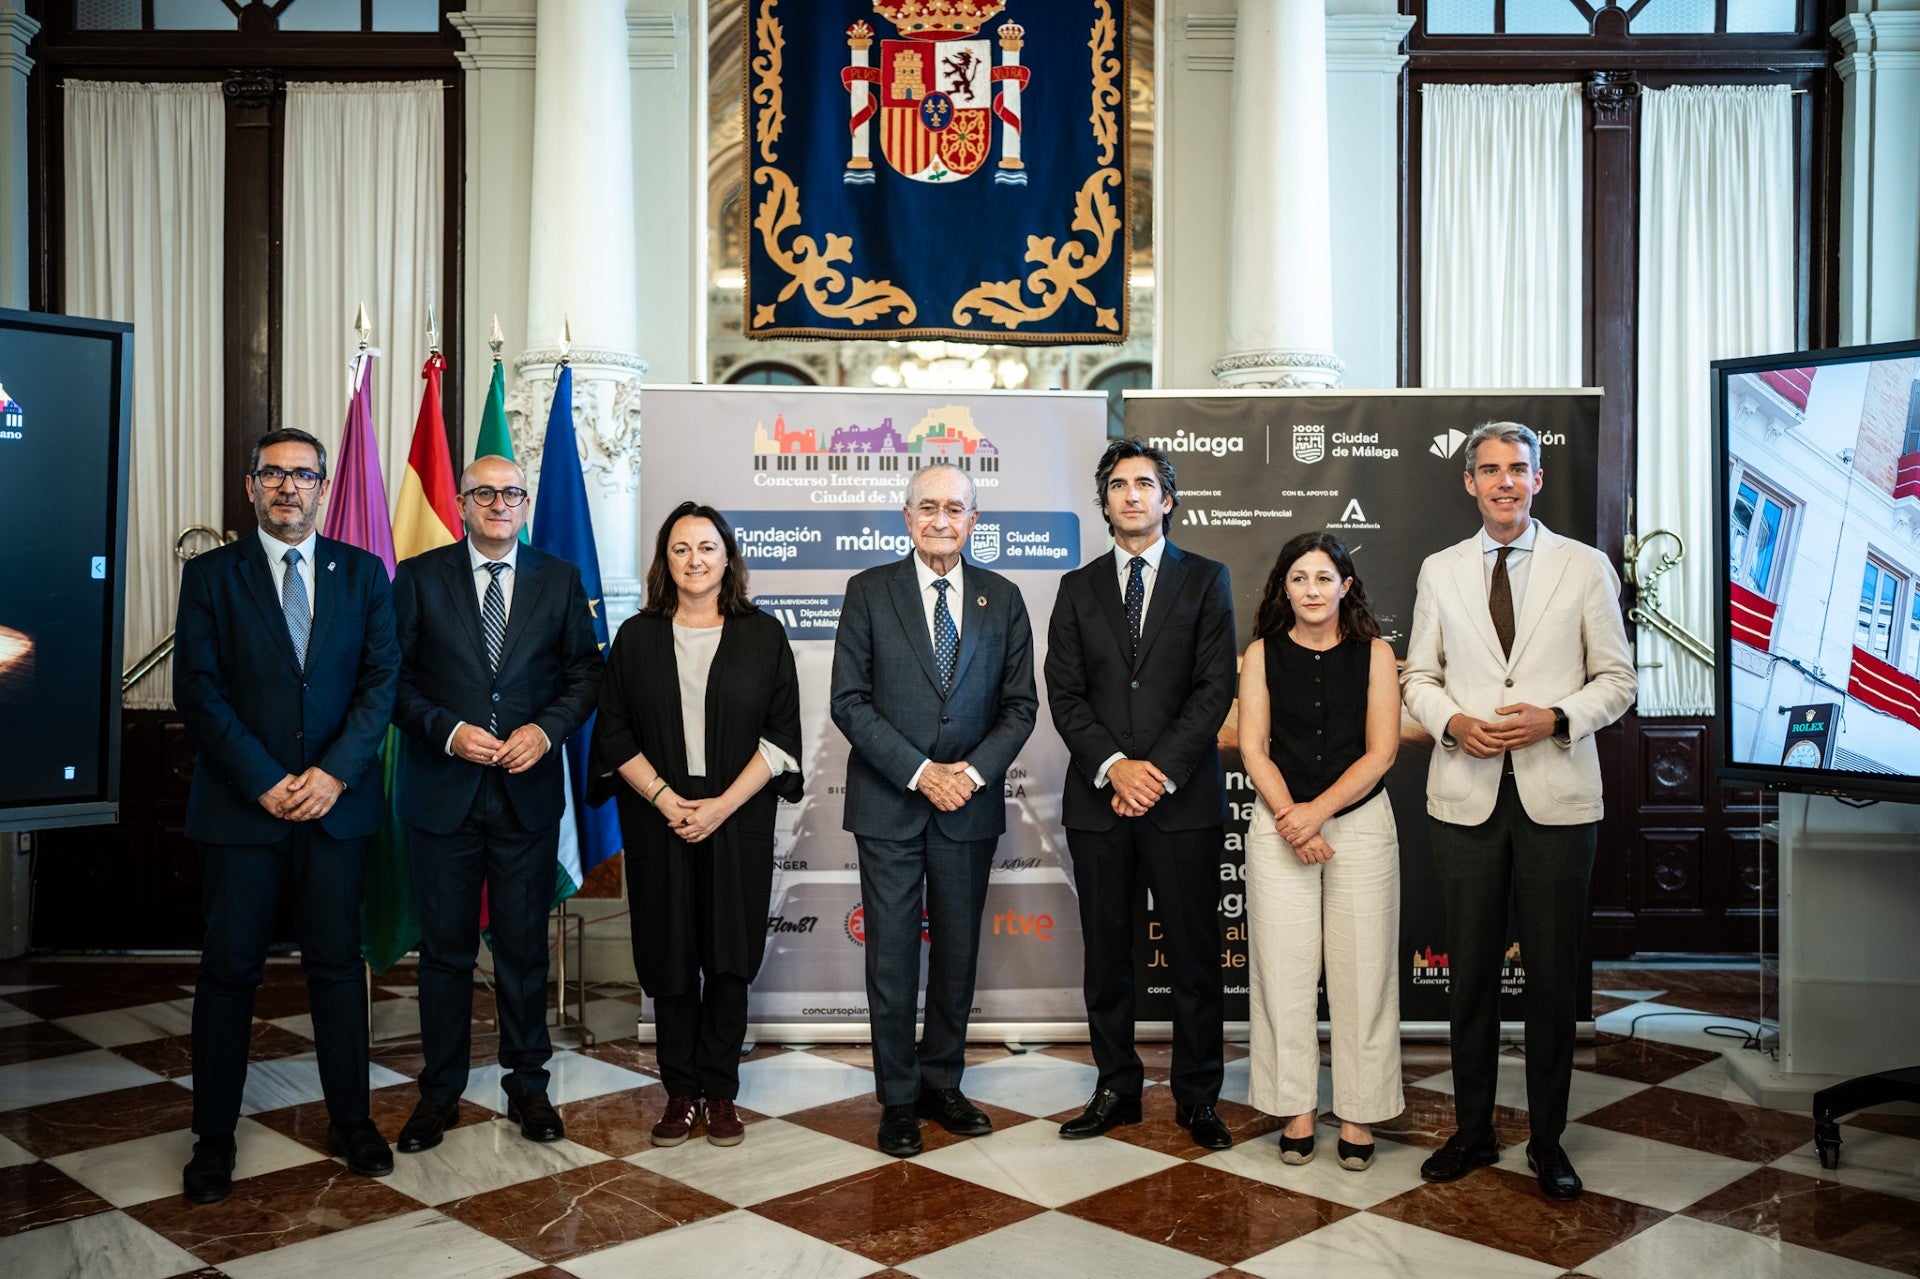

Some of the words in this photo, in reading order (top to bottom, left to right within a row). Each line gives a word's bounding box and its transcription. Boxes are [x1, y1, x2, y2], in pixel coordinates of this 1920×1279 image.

[0, 431, 22, 440] ano
[1331, 432, 1379, 444] Ciudad
[1331, 446, 1349, 457] de
[1352, 446, 1399, 459] Málaga
[754, 473, 828, 487] Concurso
[831, 473, 909, 487] Internacio
[810, 490, 866, 504] Ciudad
[868, 490, 887, 504] de
[1211, 509, 1253, 518] Diputación
[1254, 509, 1293, 517] Provincial
[1211, 518, 1222, 526] de
[1223, 517, 1251, 527] Málaga
[734, 527, 822, 543] Fundación
[1006, 531, 1050, 543] Ciudad
[836, 527, 915, 556] málag
[1006, 545, 1023, 556] de
[1024, 545, 1068, 559] Málaga
[800, 609, 841, 618] Diputació
[800, 619, 812, 627] de
[813, 618, 839, 629] Málag
[1792, 722, 1824, 732] ROLEX
[993, 909, 1055, 941] rtve
[1413, 977, 1450, 985] Concurs
